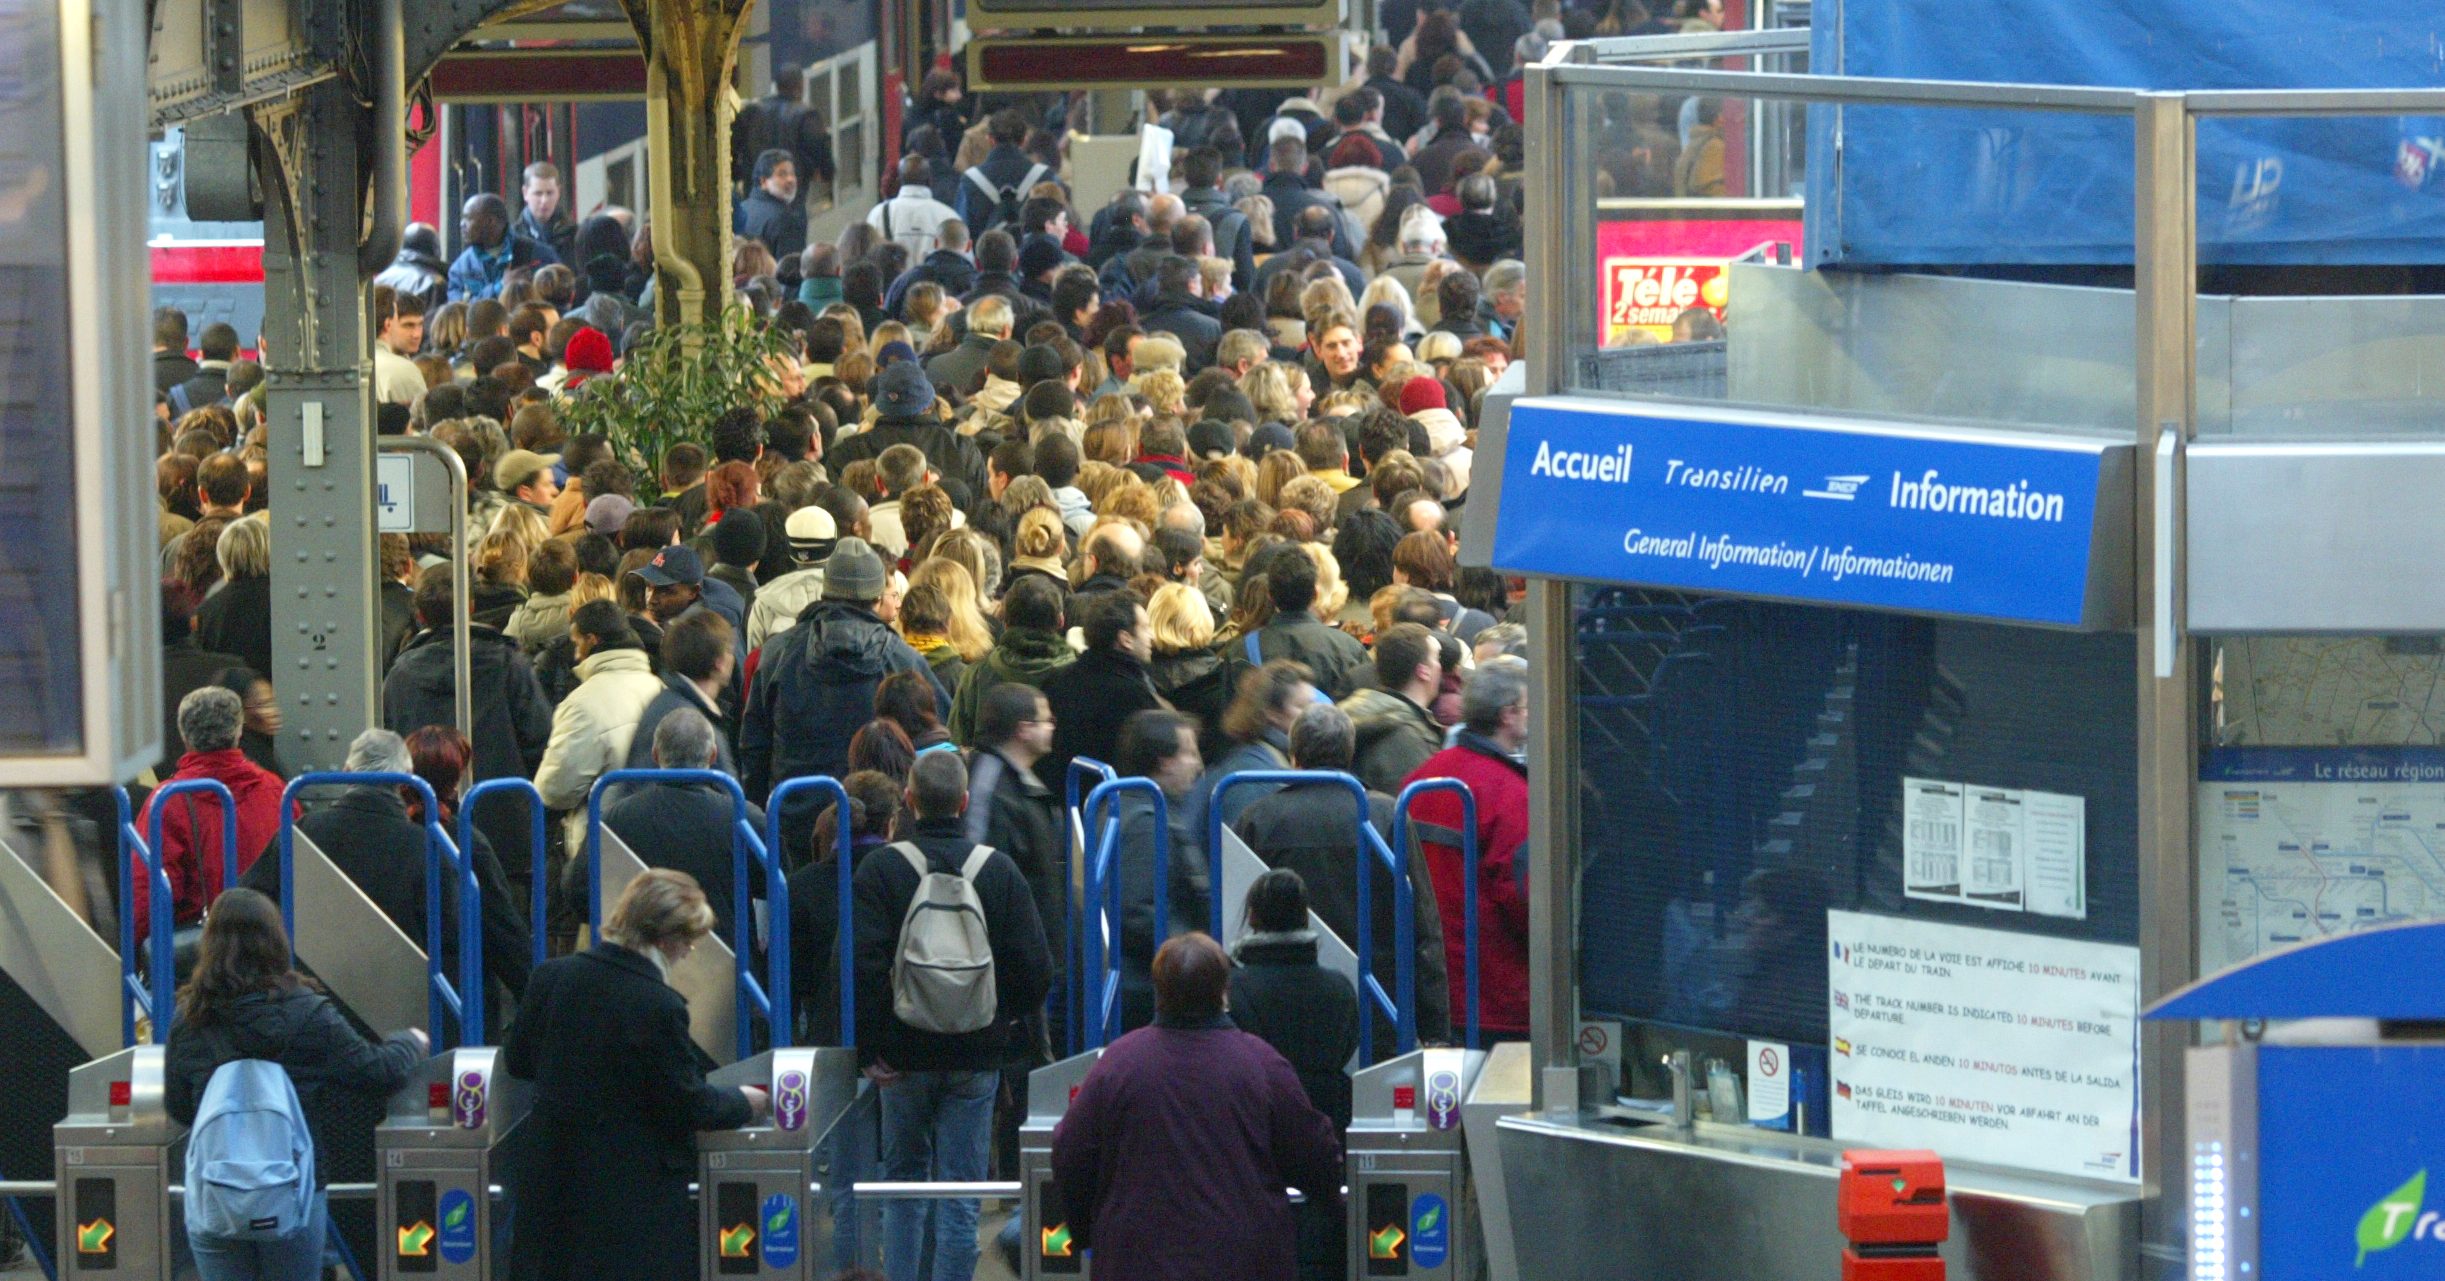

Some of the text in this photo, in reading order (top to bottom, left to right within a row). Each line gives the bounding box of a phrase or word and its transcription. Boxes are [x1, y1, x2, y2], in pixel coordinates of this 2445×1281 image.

[1617, 266, 1698, 307] Télé
[1612, 300, 1628, 323] 2
[1531, 440, 1633, 484] Accueil
[1665, 460, 1788, 494] Transilien
[1890, 469, 2064, 522] Information
[1624, 528, 1695, 559] General
[1820, 546, 1953, 583] Informationen
[312, 634, 326, 650] 2
[2315, 763, 2332, 779] Le
[2338, 761, 2389, 779] réseau
[1853, 942, 2122, 984] LE NUMERO DE LA VOIE EST AFFICHE 10 MINUTES AVANT
[1853, 956, 1866, 968] LE
[1868, 958, 1901, 972] DEPART
[1905, 962, 1918, 975] DU
[1854, 993, 2112, 1037] THE TRACK NUMBER IS INDICATED 10 MINUTES BEFORE
[1856, 1044, 1867, 1056] SE
[1870, 1046, 1906, 1062] CONOCE
[1909, 1051, 1921, 1064] EL
[1923, 1054, 1956, 1068] ANDEN
[1959, 1057, 1970, 1069] 10
[1973, 1061, 2019, 1076] MINUTOS
[2021, 1067, 2052, 1081] ANTES
[2054, 1070, 2068, 1083] DE
[2070, 1072, 2083, 1084] LA
[1855, 1085, 2100, 1127] DAS GLEIS WIRD 10 MINUTEN VOR ABFAHRT AN DER
[1855, 1100, 1887, 1114] TAFFEL
[1890, 1106, 1966, 1124] ANGESCHRIEBEN
